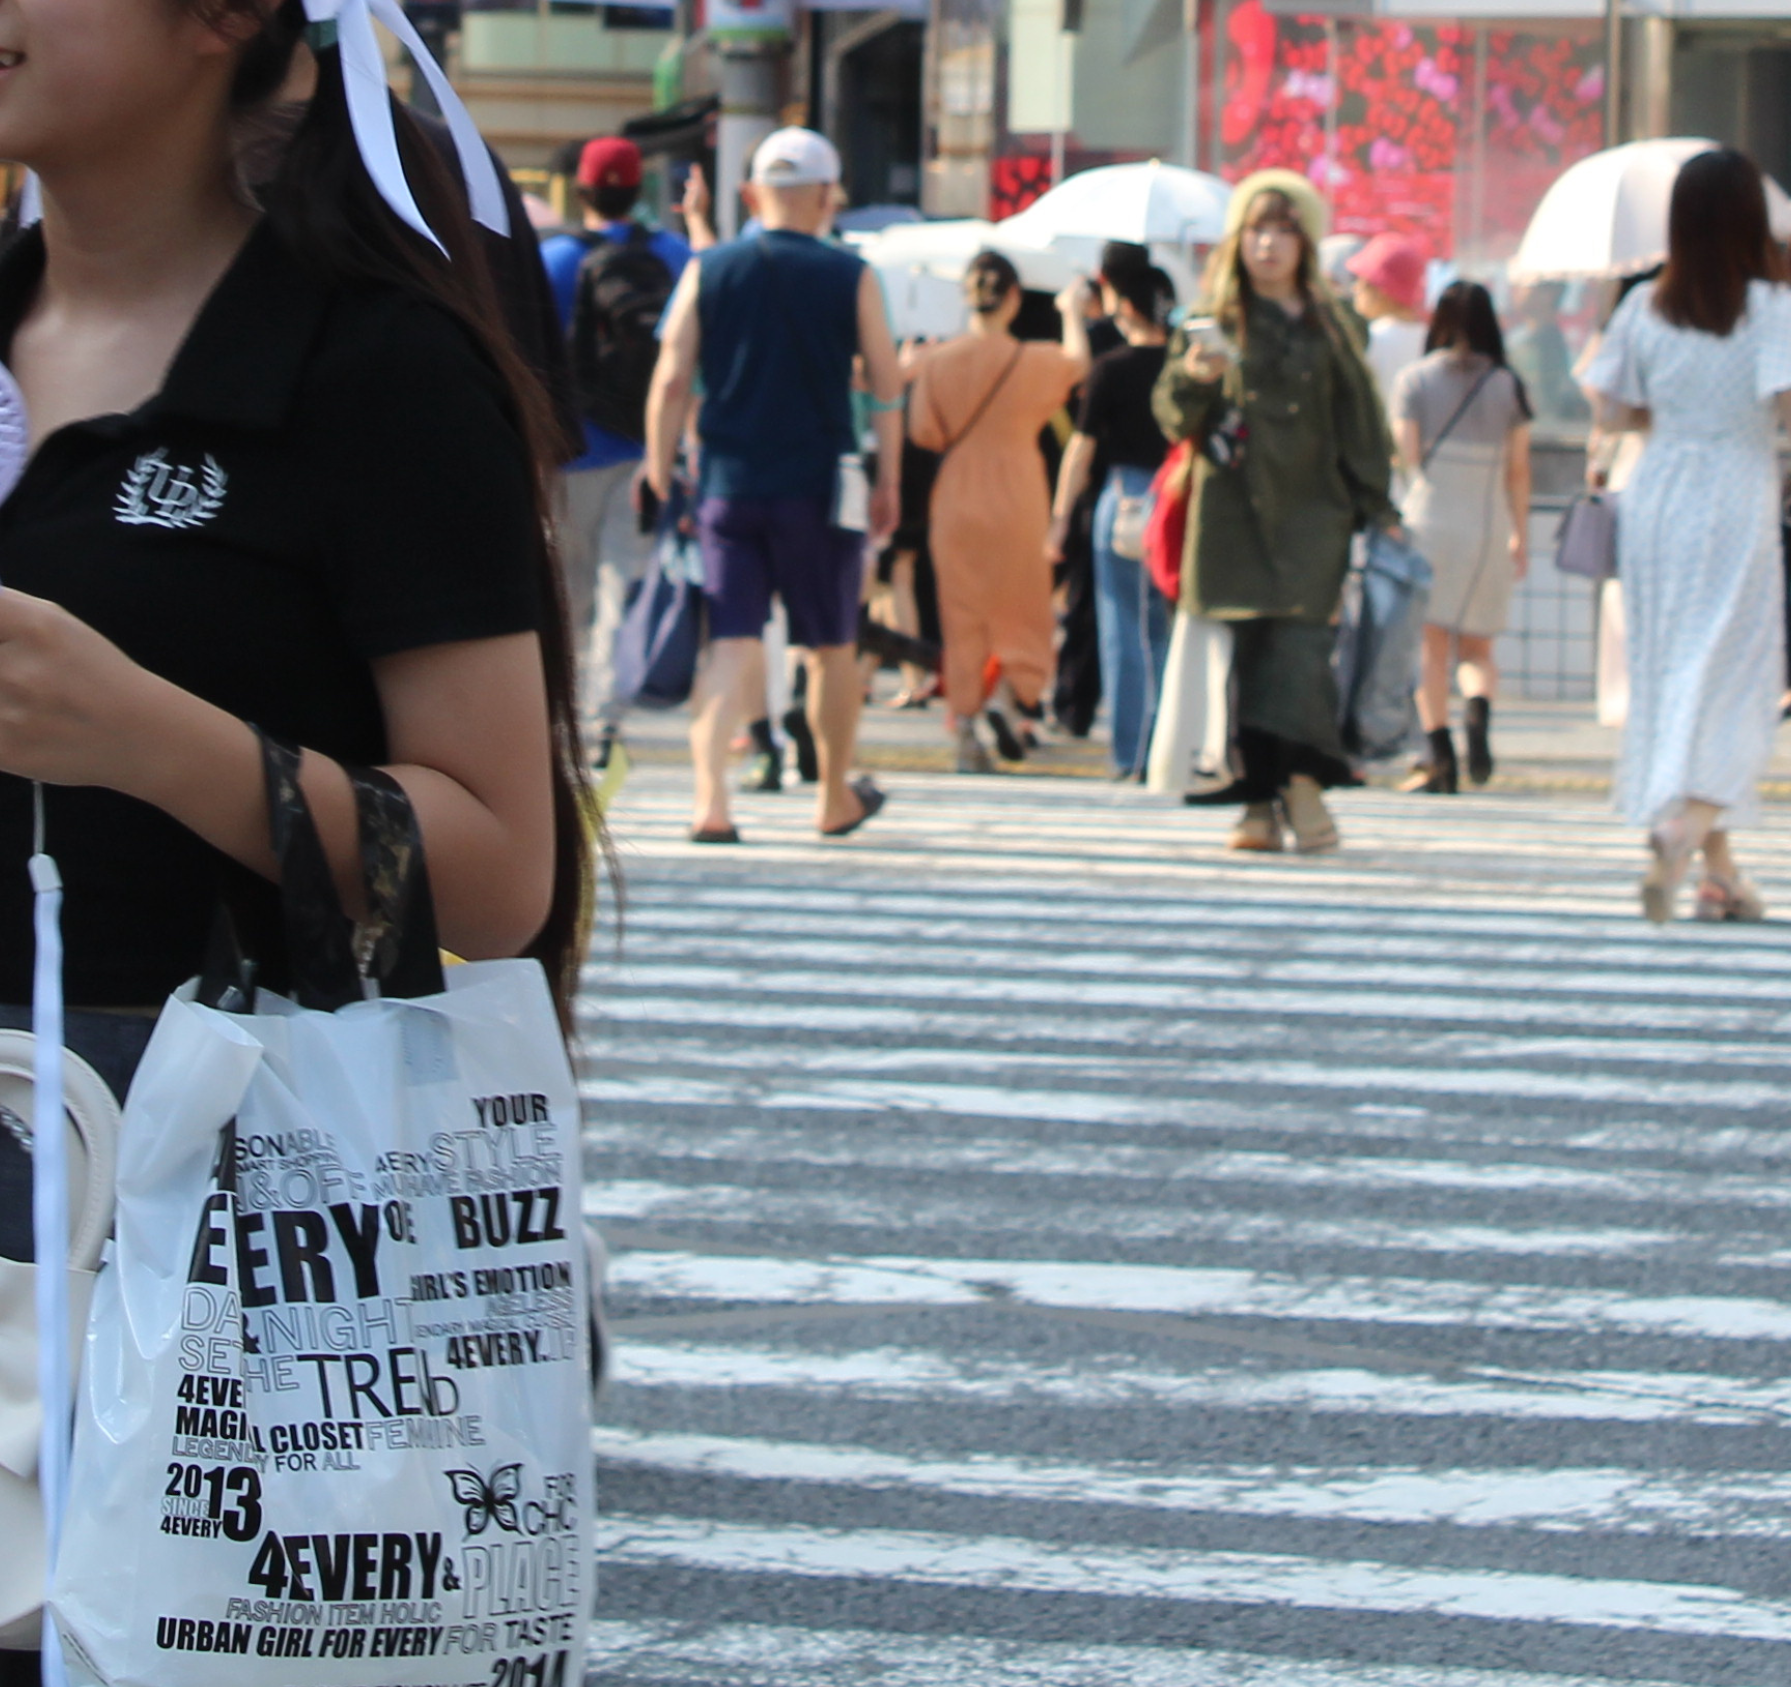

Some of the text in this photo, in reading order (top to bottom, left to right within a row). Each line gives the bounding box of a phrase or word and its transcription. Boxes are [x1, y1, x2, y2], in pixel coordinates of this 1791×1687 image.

[472, 1093, 549, 1128] YOUR
[429, 1123, 563, 1173] STYLE
[450, 1187, 567, 1250] BUZZ
[472, 1261, 572, 1297] EMOTION
[262, 1297, 415, 1354] NIGHT
[270, 1422, 364, 1454] CLOSET
[275, 1453, 318, 1472] FOR
[322, 1450, 361, 1470] ALL
[161, 1497, 209, 1517] SINCE
[164, 1462, 263, 1542] 2013
[159, 1515, 223, 1539] 4EVERY
[247, 1531, 580, 1619] 4EVERY & PLACE
[225, 1597, 443, 1625] FASHION ITEM HOLIC
[156, 1612, 576, 1659] URBAN GIRL FOR EVERY FOR TASTE
